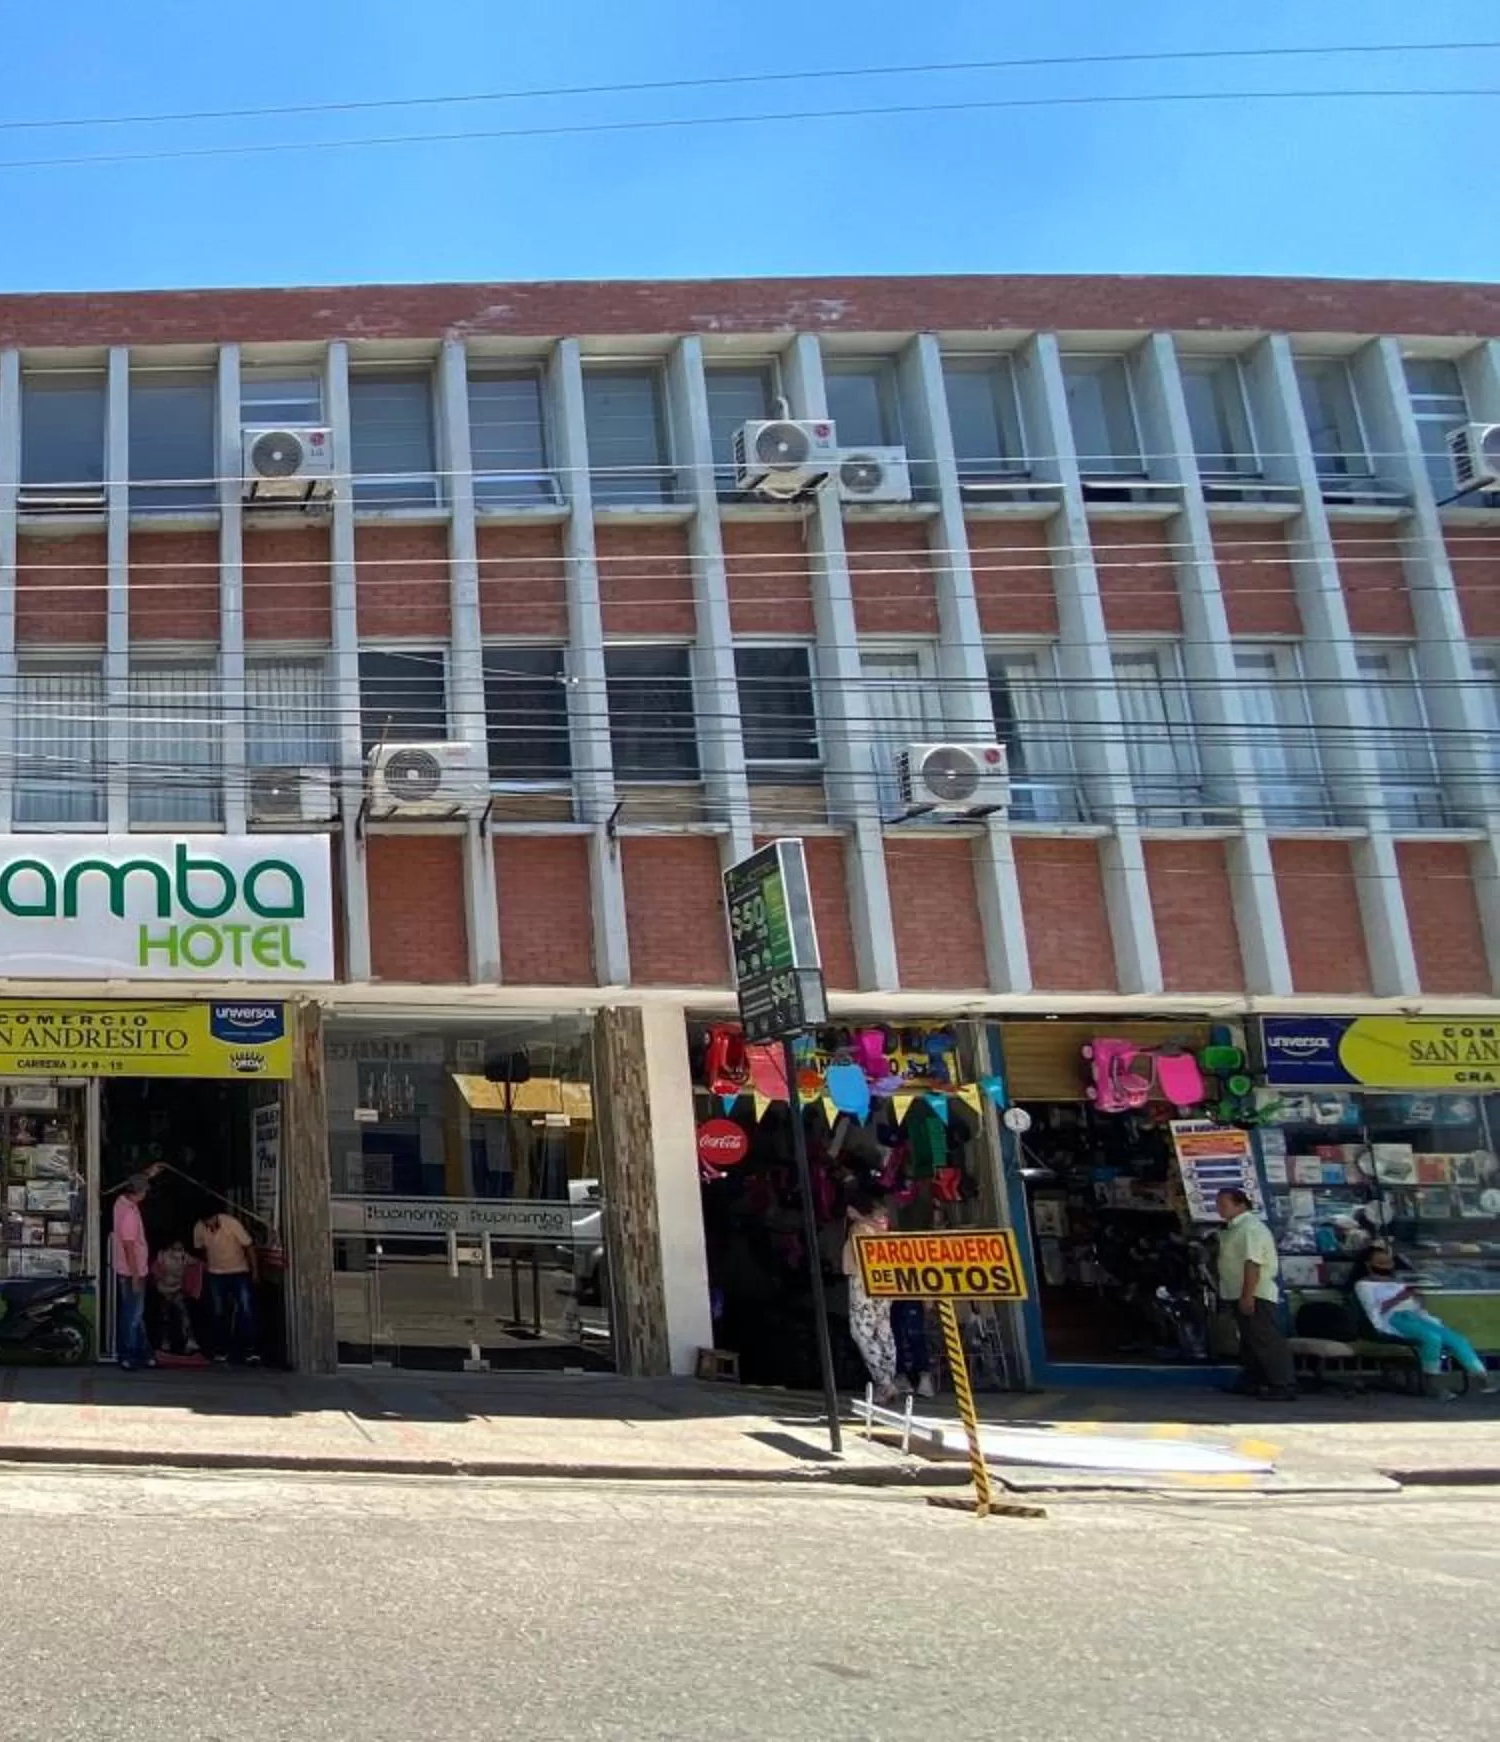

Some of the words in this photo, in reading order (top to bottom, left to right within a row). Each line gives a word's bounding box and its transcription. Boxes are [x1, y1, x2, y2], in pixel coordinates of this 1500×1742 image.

[139, 924, 306, 968] HOTEL
[20, 1027, 189, 1050] ANDRESITO
[1443, 1028, 1495, 1038] COM
[1408, 1039, 1459, 1061] SAN
[1455, 1072, 1495, 1083] CRA
[864, 1238, 1004, 1264] PARQUEADERO
[871, 1269, 893, 1283] DE
[893, 1266, 1012, 1292] MOTOS
